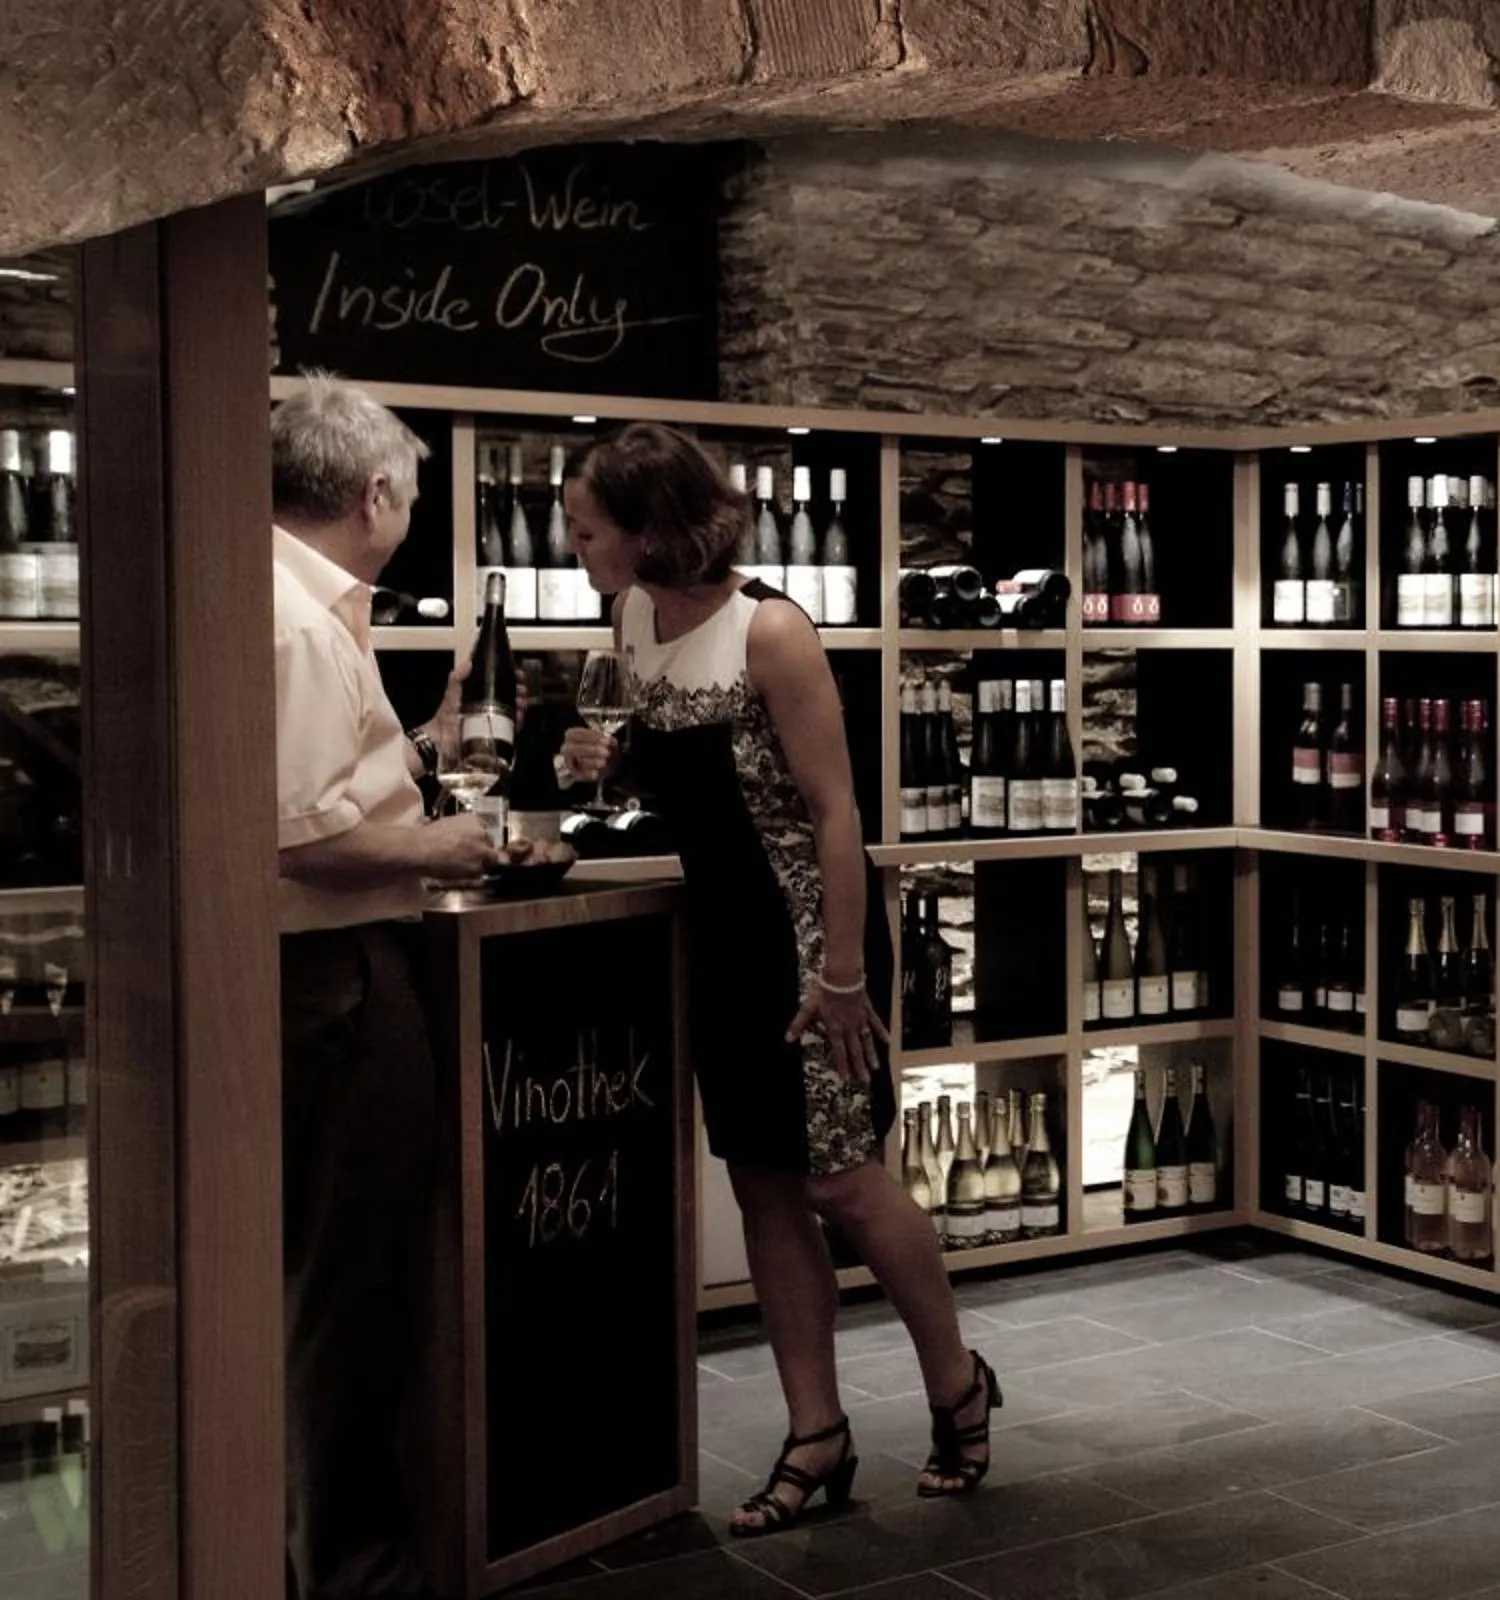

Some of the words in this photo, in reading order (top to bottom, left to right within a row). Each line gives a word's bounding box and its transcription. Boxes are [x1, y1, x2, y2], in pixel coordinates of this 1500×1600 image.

[308, 250, 480, 334] Inside
[497, 261, 702, 364] Only
[483, 1024, 657, 1136] Vinothek
[514, 1149, 619, 1249] 1861
